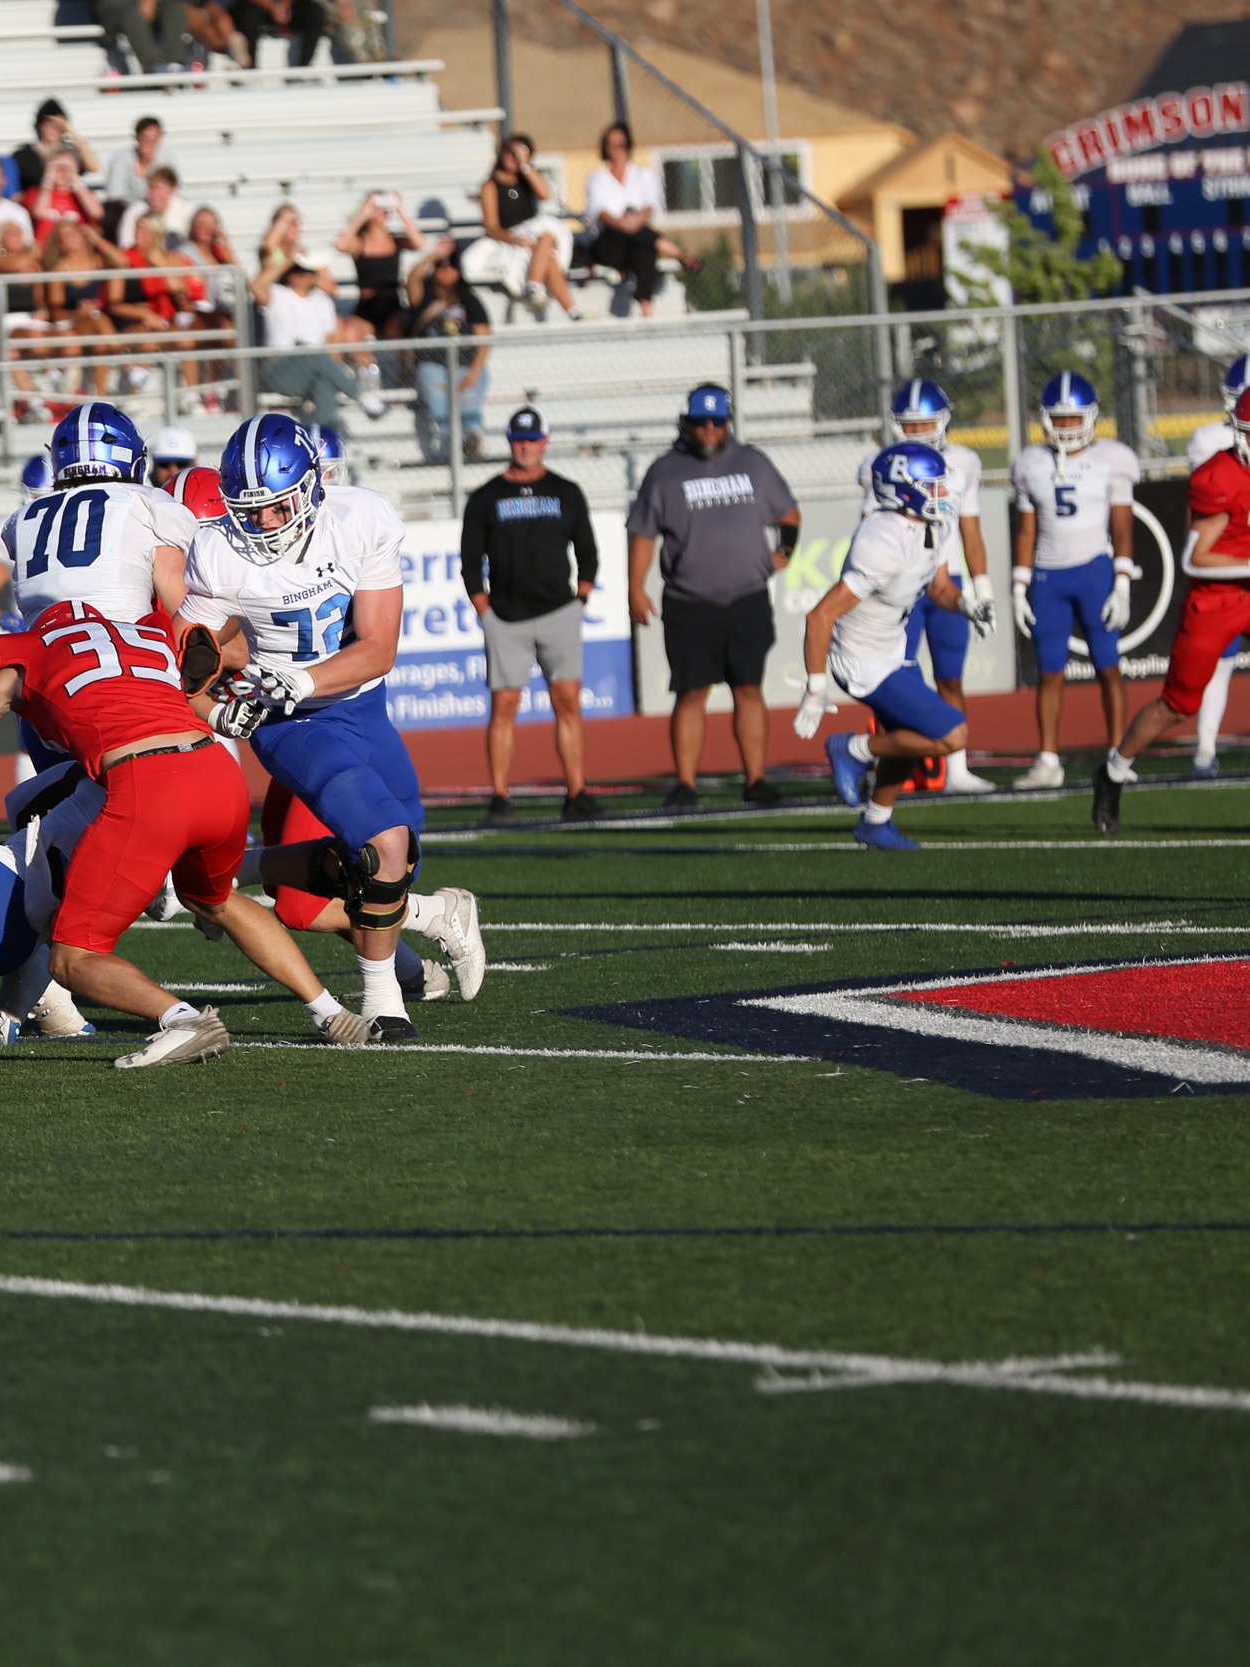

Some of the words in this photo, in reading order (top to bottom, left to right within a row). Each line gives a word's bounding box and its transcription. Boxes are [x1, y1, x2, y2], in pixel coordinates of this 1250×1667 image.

[1048, 84, 1248, 176] CRIMSON
[294, 425, 316, 460] 72
[63, 463, 107, 479] BINGHAM
[243, 490, 265, 498] FINISH
[682, 474, 754, 503] BINGHAM
[1055, 487, 1078, 517] 5
[23, 489, 110, 579] 70
[282, 580, 333, 605] BINGHAM
[270, 592, 353, 662] 72
[41, 621, 182, 697] 35
[398, 690, 487, 720] Finishes
